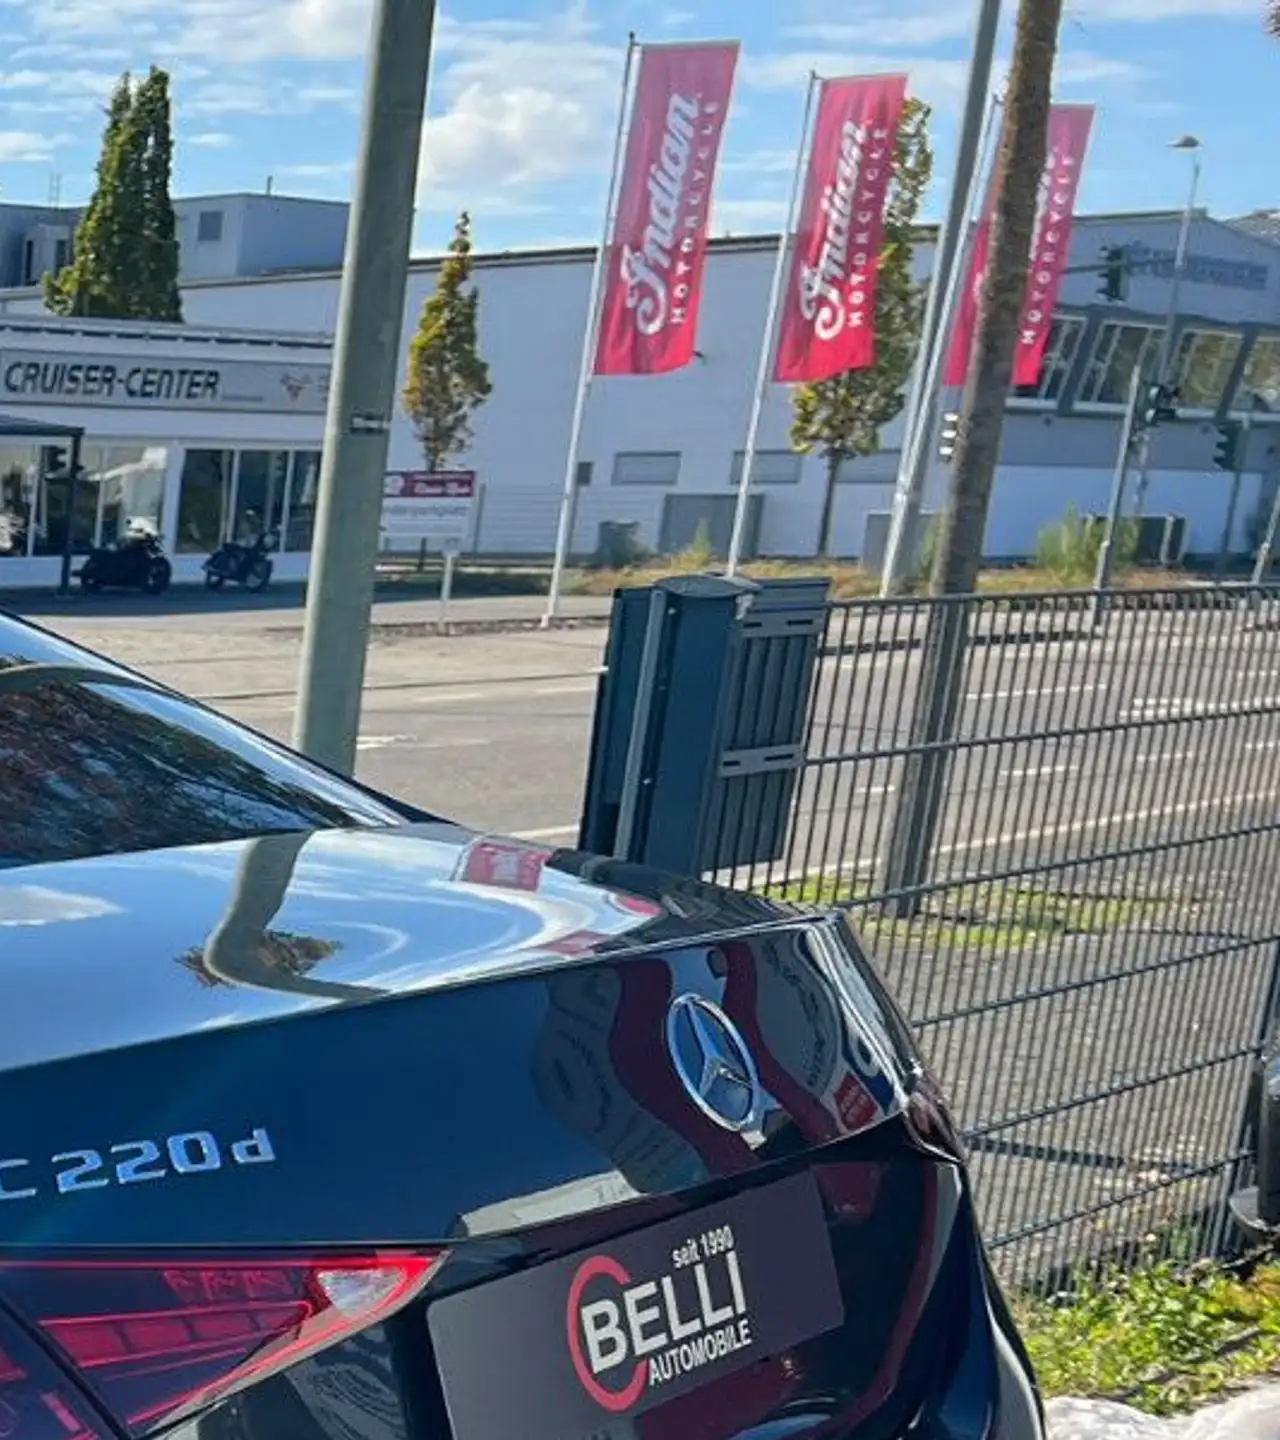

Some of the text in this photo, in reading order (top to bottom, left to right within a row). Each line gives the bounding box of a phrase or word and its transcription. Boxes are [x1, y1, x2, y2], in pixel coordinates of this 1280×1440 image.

[620, 93, 701, 335] Indian
[669, 100, 721, 323] MOTORCYCLE
[799, 118, 871, 340] Indian
[848, 127, 888, 328] MOTORCYCLE
[1020, 152, 1074, 345] MOTORCYCLE
[4, 360, 220, 400] CRUISER-CENTER
[580, 1250, 747, 1375] BELLI
[672, 1238, 701, 1269] seit
[647, 1319, 753, 1386] AUTOMOBILE
